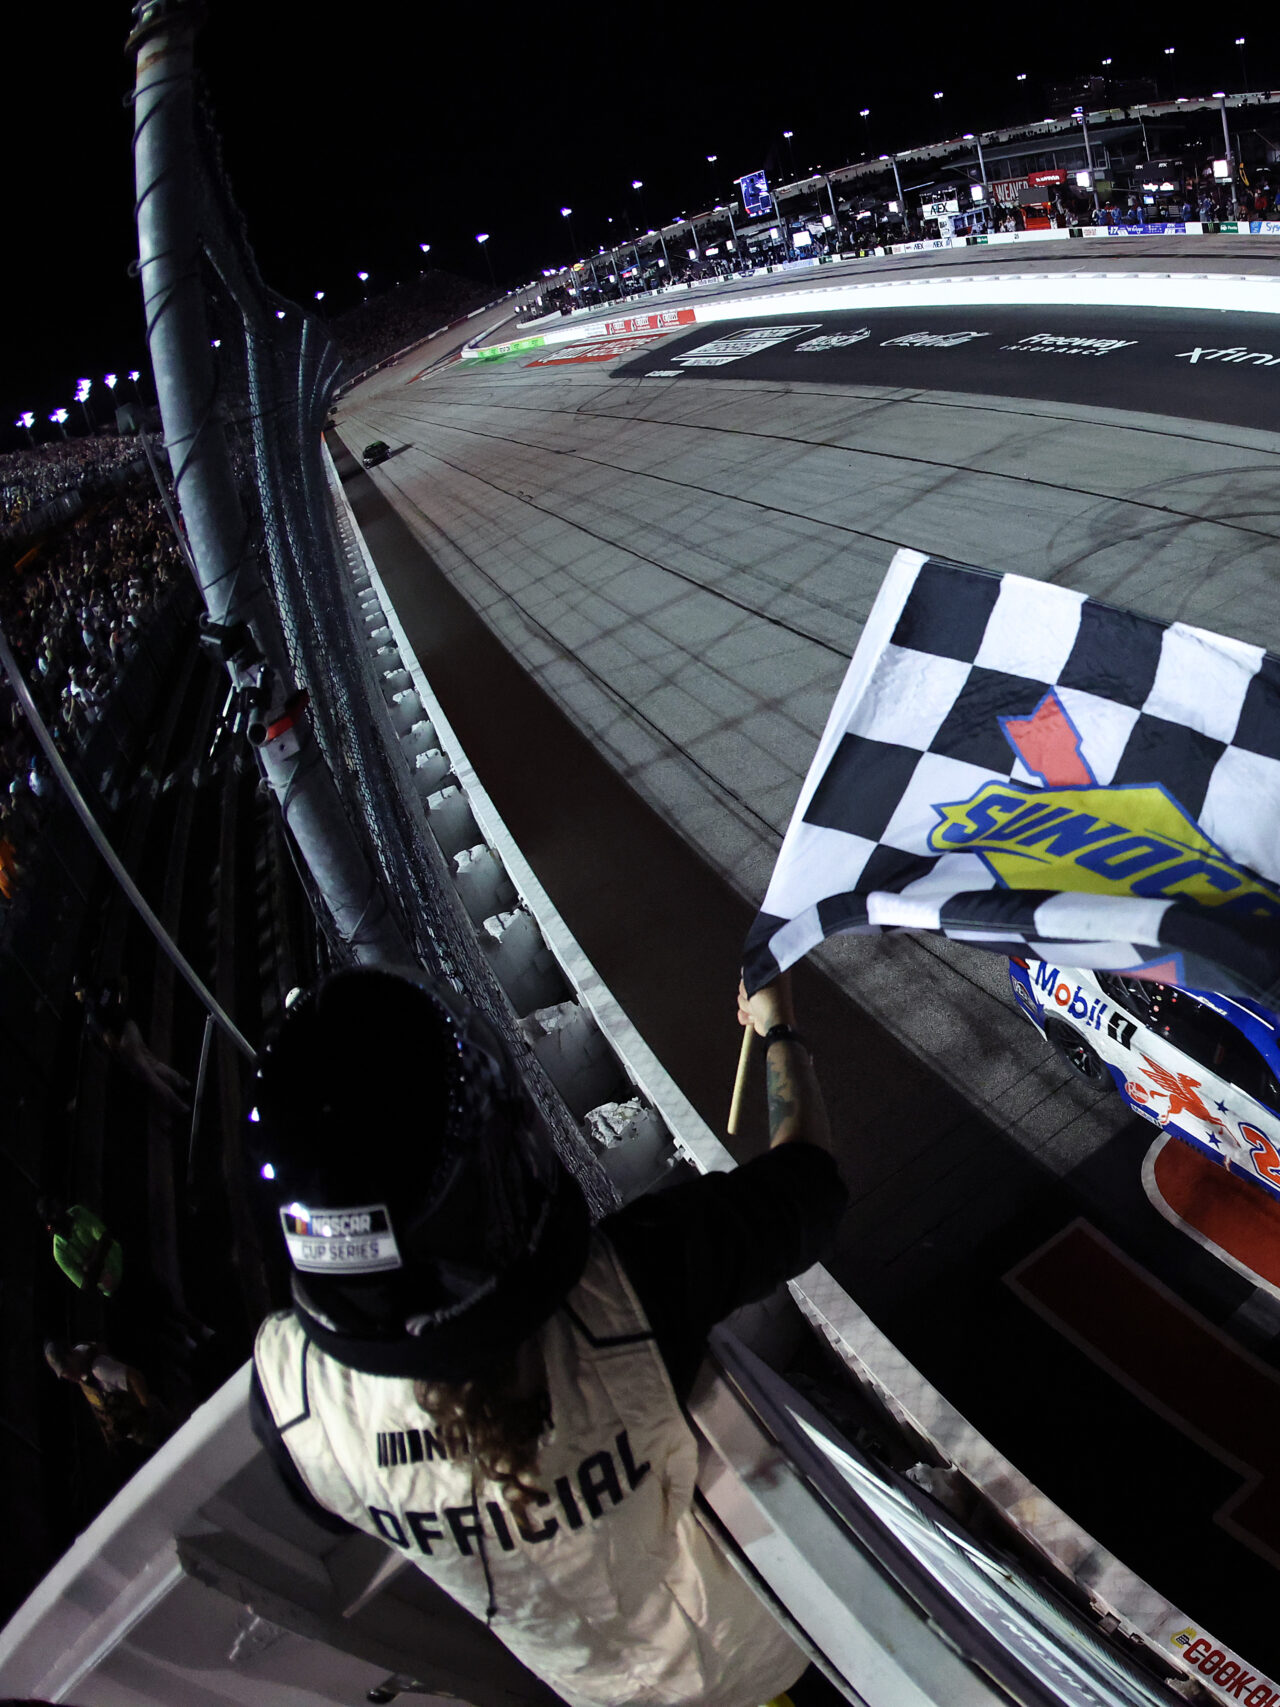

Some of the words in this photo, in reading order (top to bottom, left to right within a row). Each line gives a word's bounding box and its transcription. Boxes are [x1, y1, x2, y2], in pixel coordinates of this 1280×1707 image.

[1000, 345, 1109, 357] INSURANCE
[1018, 333, 1138, 350] Freeway
[1035, 961, 1108, 1031] Mobil
[311, 1213, 371, 1238] NASCAR
[302, 1244, 326, 1260] CUP
[329, 1241, 379, 1260] SERIES
[368, 1430, 651, 1556] OFFICIAL
[1183, 1638, 1256, 1700] COOK
